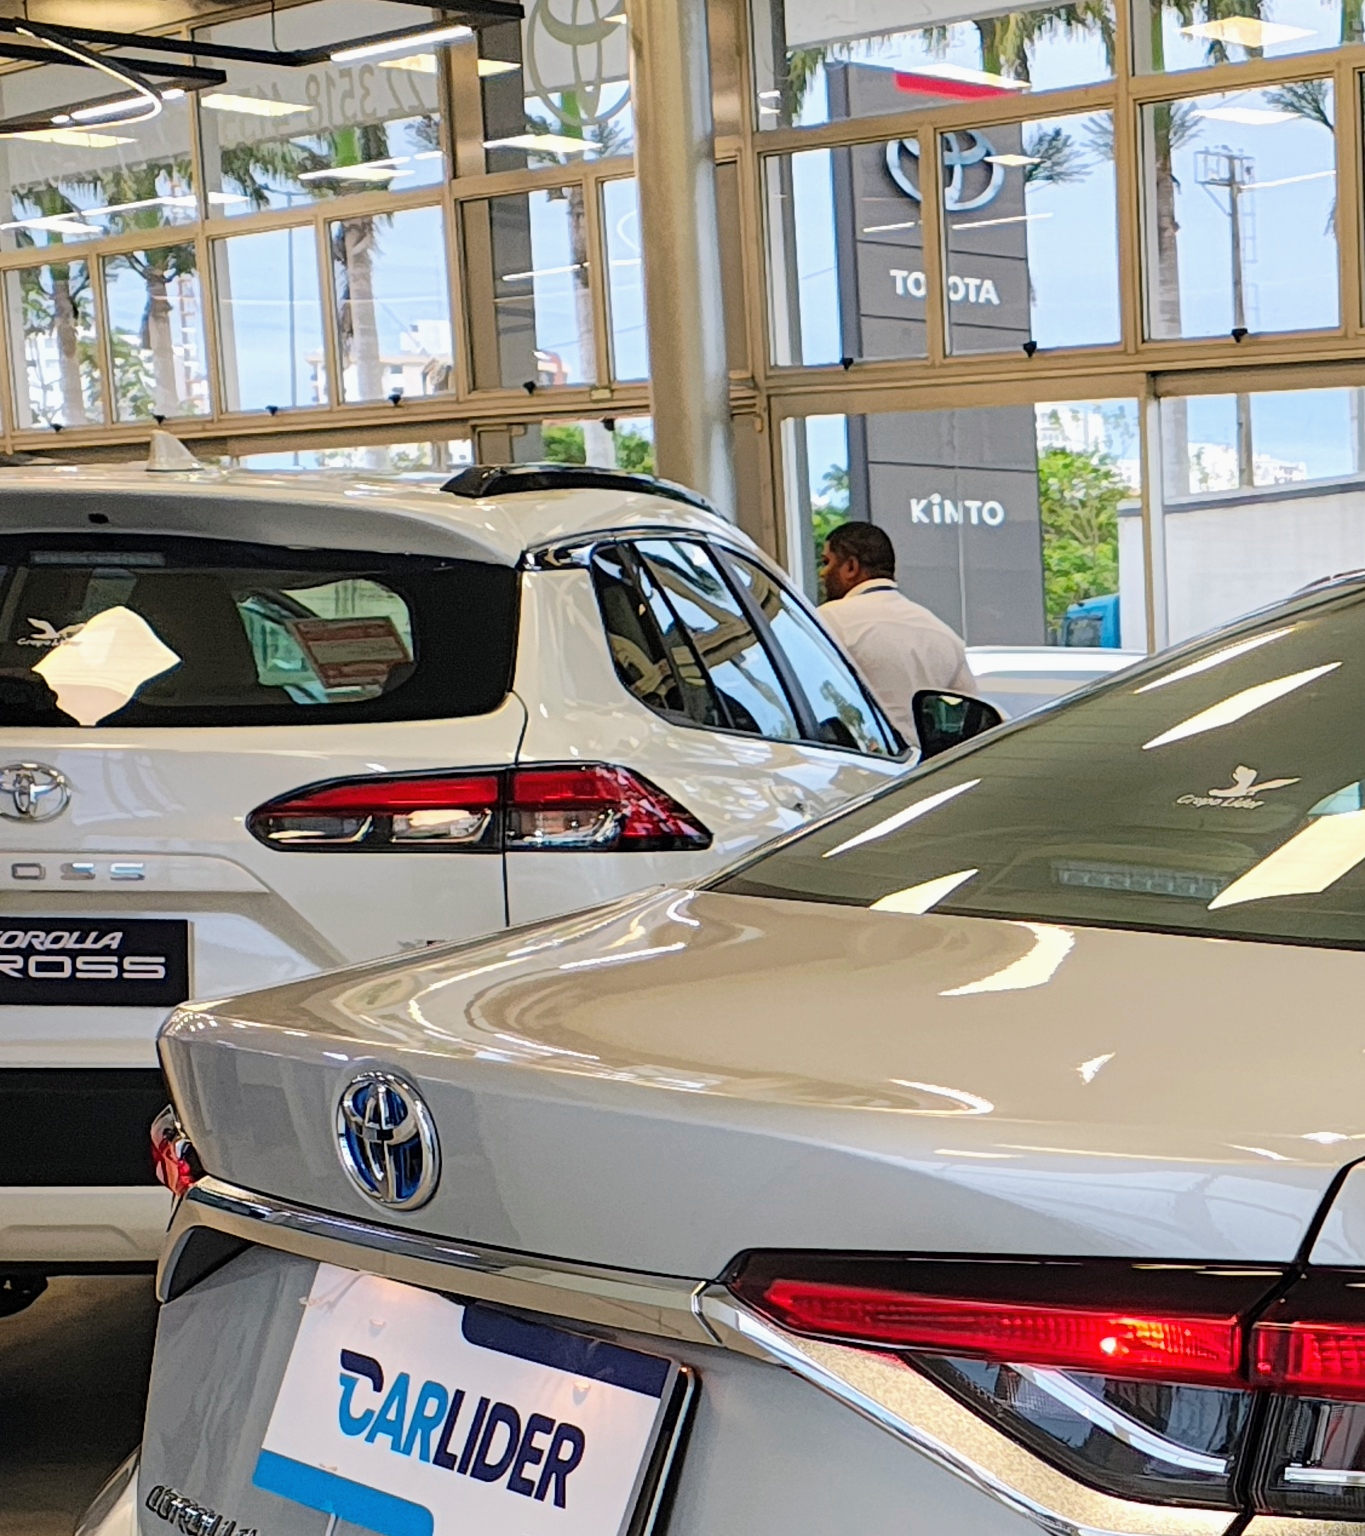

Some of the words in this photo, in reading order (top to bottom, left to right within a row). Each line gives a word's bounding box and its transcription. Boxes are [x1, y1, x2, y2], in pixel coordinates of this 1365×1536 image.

[888, 268, 1001, 306] TOOTA
[0, 930, 124, 951] OROLLA
[338, 1347, 586, 1510] CARLIDER
